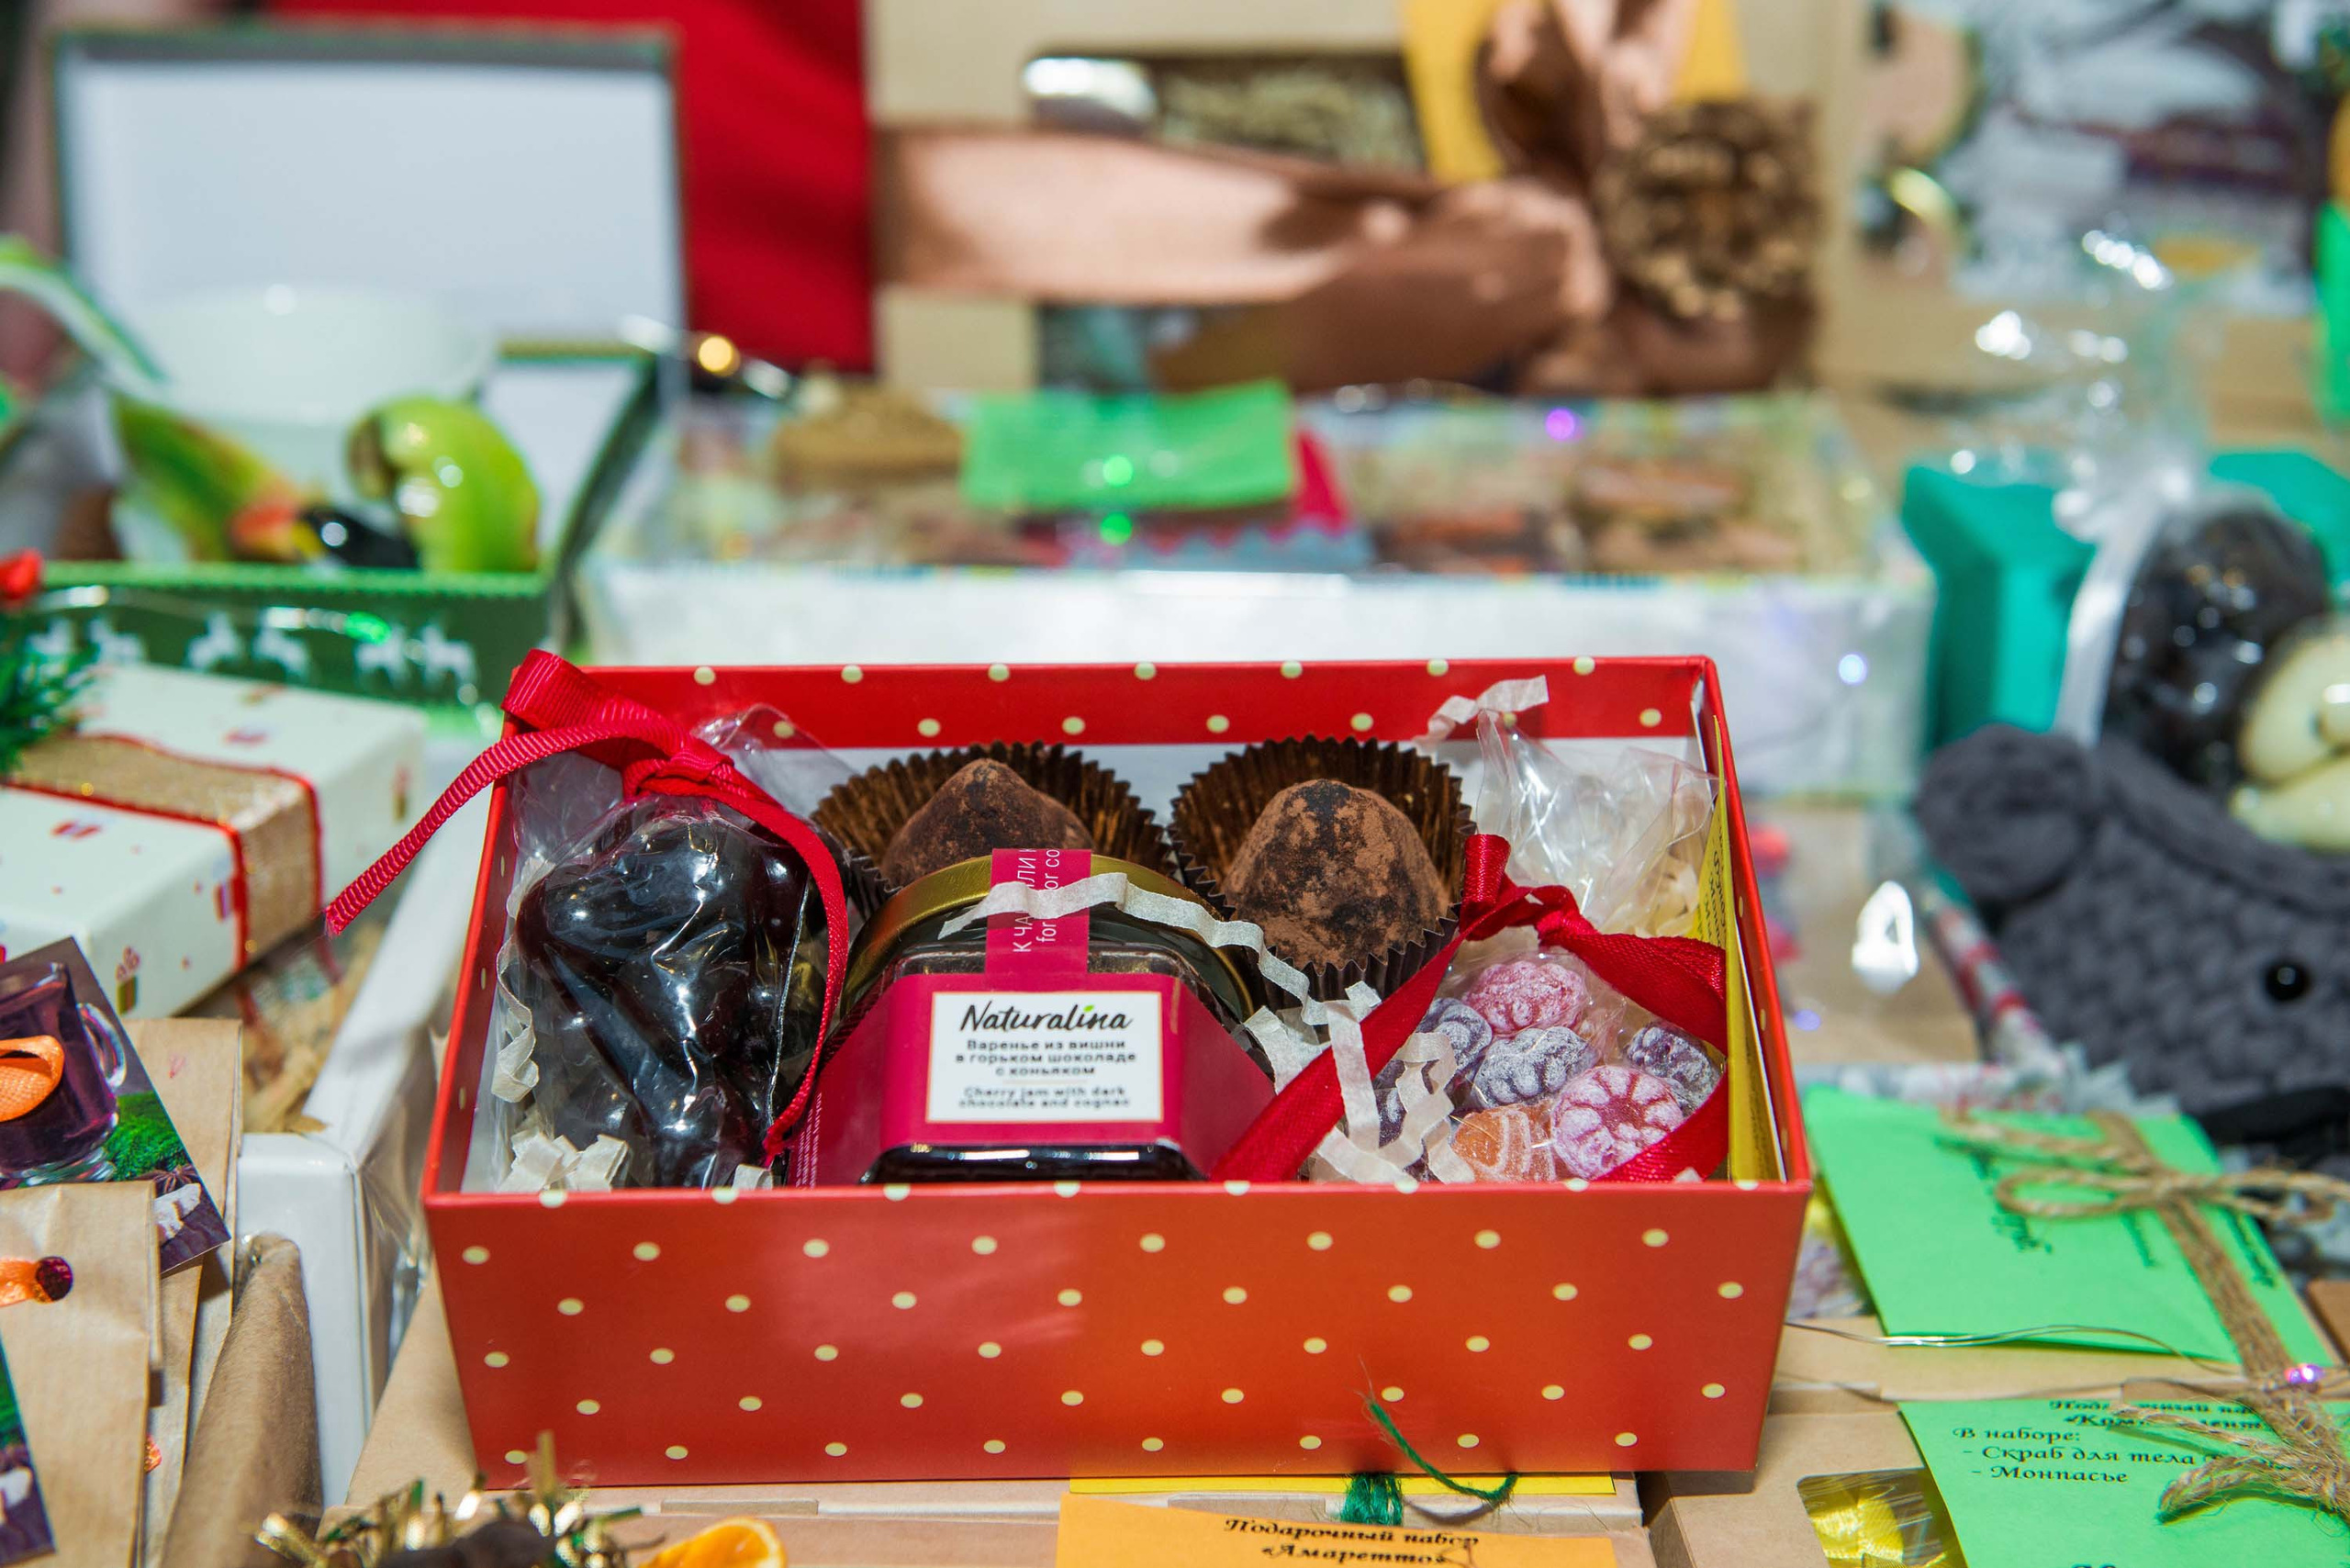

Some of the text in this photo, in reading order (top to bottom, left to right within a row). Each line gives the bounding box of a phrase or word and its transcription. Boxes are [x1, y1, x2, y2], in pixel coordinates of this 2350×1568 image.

[1035, 849, 1060, 942] for or co
[1013, 910, 1033, 936] ЧА
[1013, 941, 1032, 952] К
[959, 1000, 1134, 1032] Naturalina
[967, 1039, 1125, 1052] Варенье из вишни
[969, 1055, 1042, 1065] горьком
[1047, 1054, 1136, 1063] шоколаде
[995, 1067, 1095, 1076] с коньяком
[965, 1086, 1125, 1100] Cherry jam with dark
[959, 1099, 1130, 1109] chocolate and cognac
[1953, 1428, 2080, 1444] В наборе:
[1982, 1446, 2065, 1462] Скраб
[2073, 1448, 2121, 1462] для
[2129, 1452, 2195, 1465] тела
[1990, 1466, 2129, 1484] Монпасье
[1225, 1519, 1480, 1548] Подарочный набор
[1262, 1544, 1448, 1563] «Амаретто»
